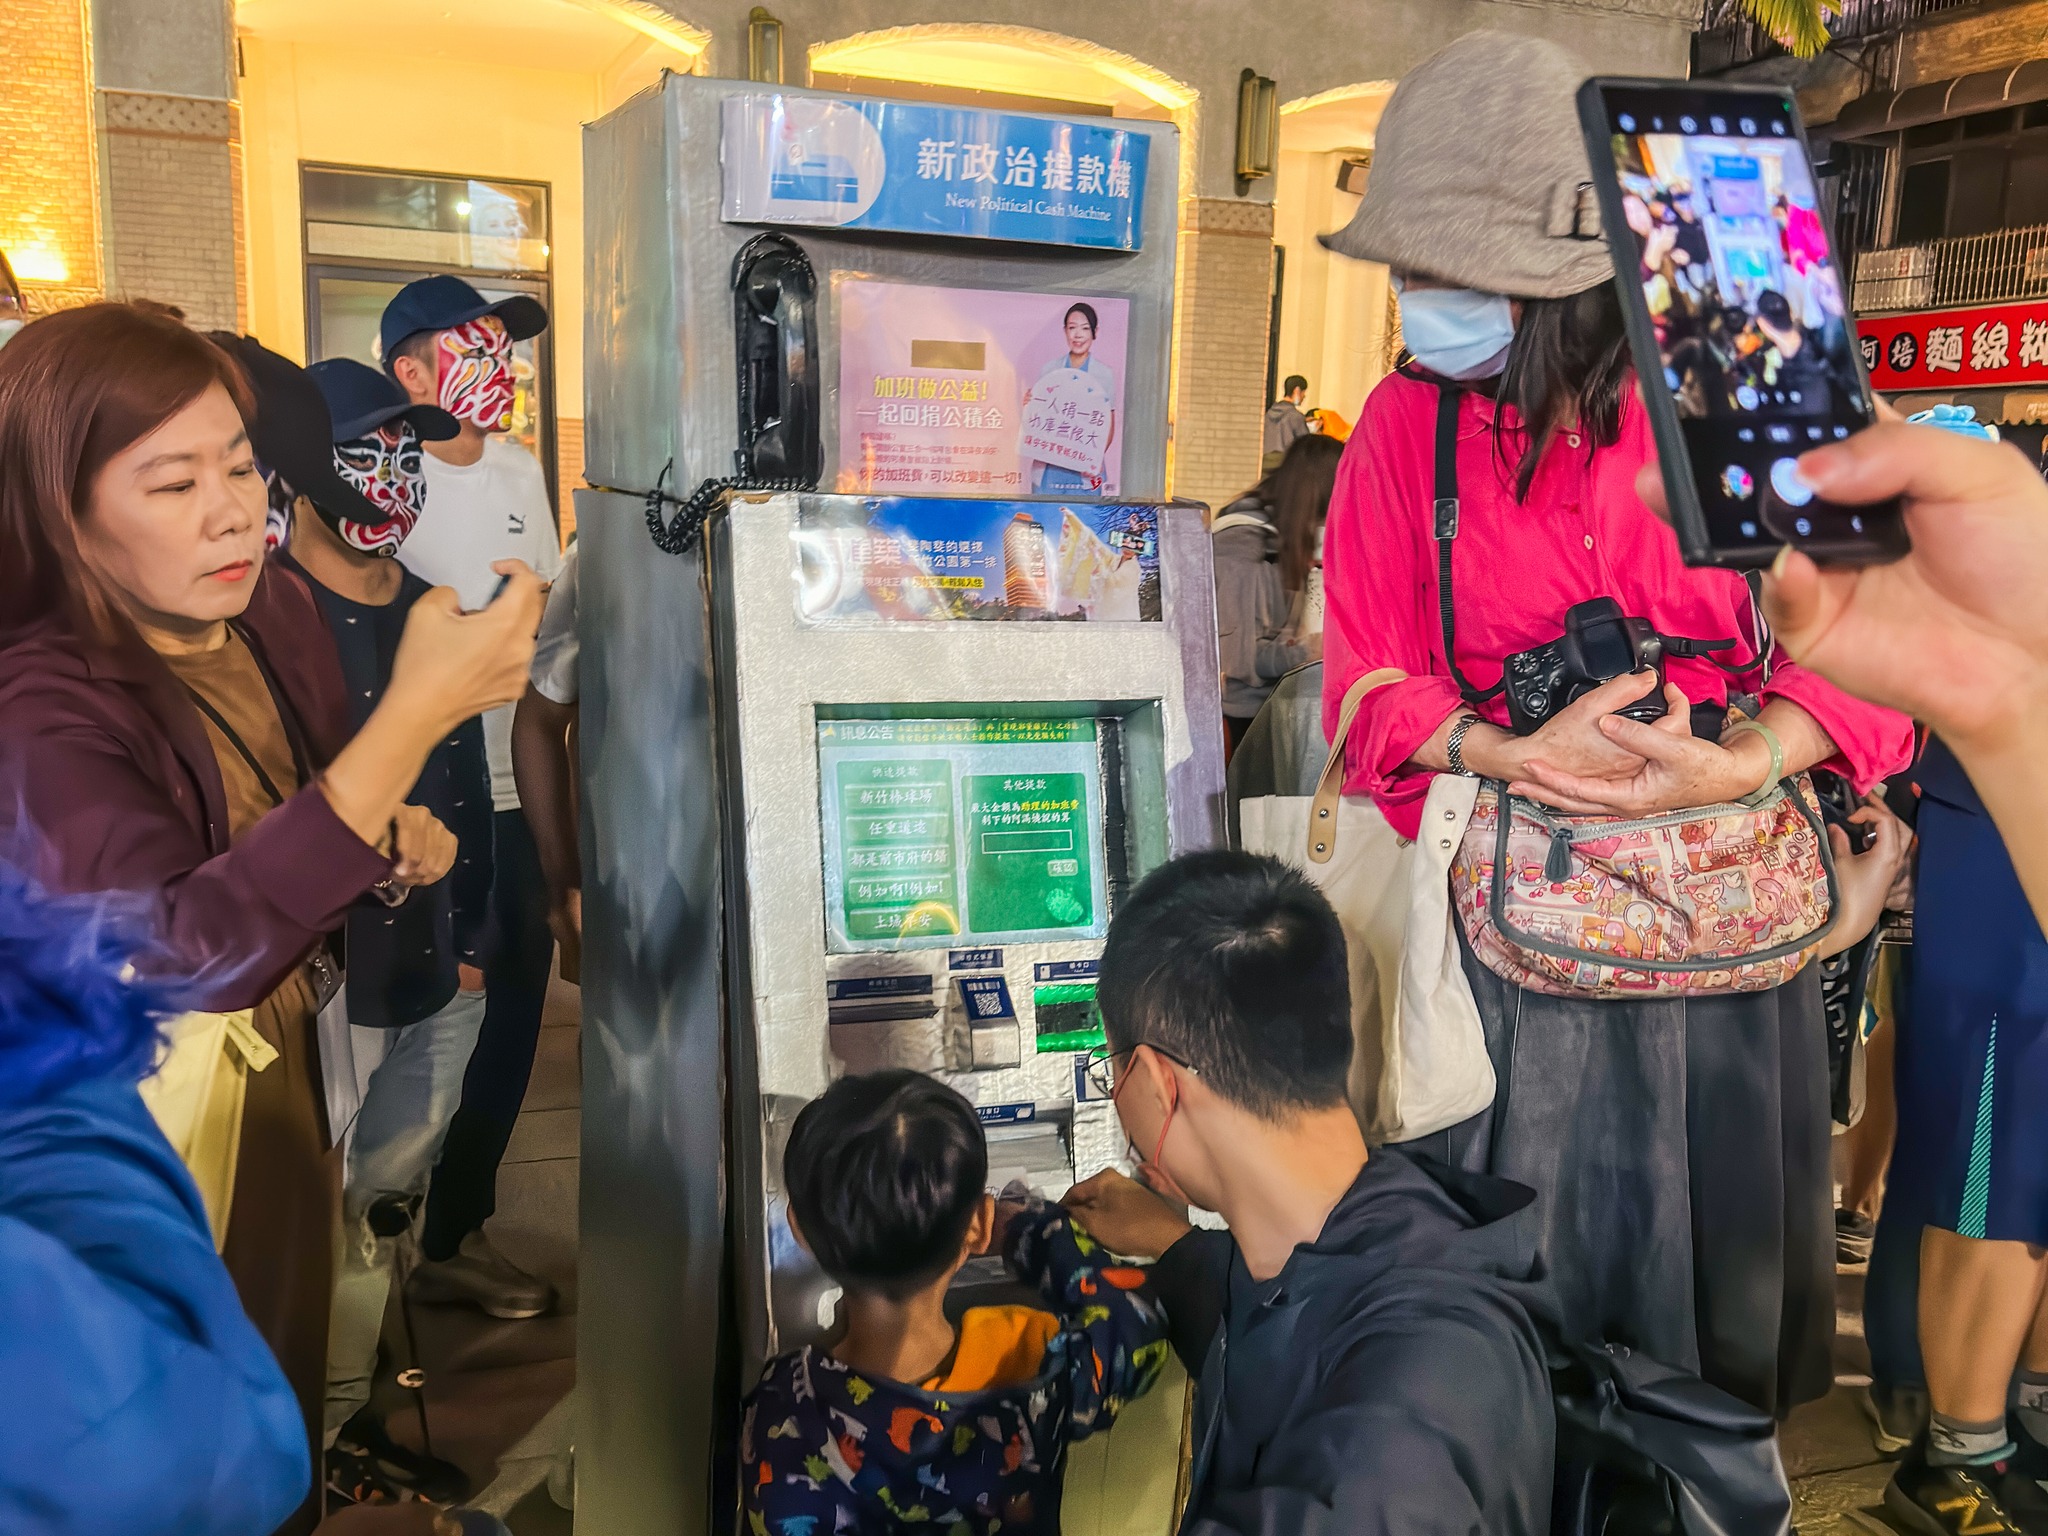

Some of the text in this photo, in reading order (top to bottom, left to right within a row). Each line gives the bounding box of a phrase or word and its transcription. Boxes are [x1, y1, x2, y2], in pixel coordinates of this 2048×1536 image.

[916, 137, 1133, 199] 新政治提款機
[945, 192, 1112, 223] New Political Cash Machine
[874, 375, 988, 402] 加班做公益!
[856, 402, 1004, 430] 一起回捐公積金
